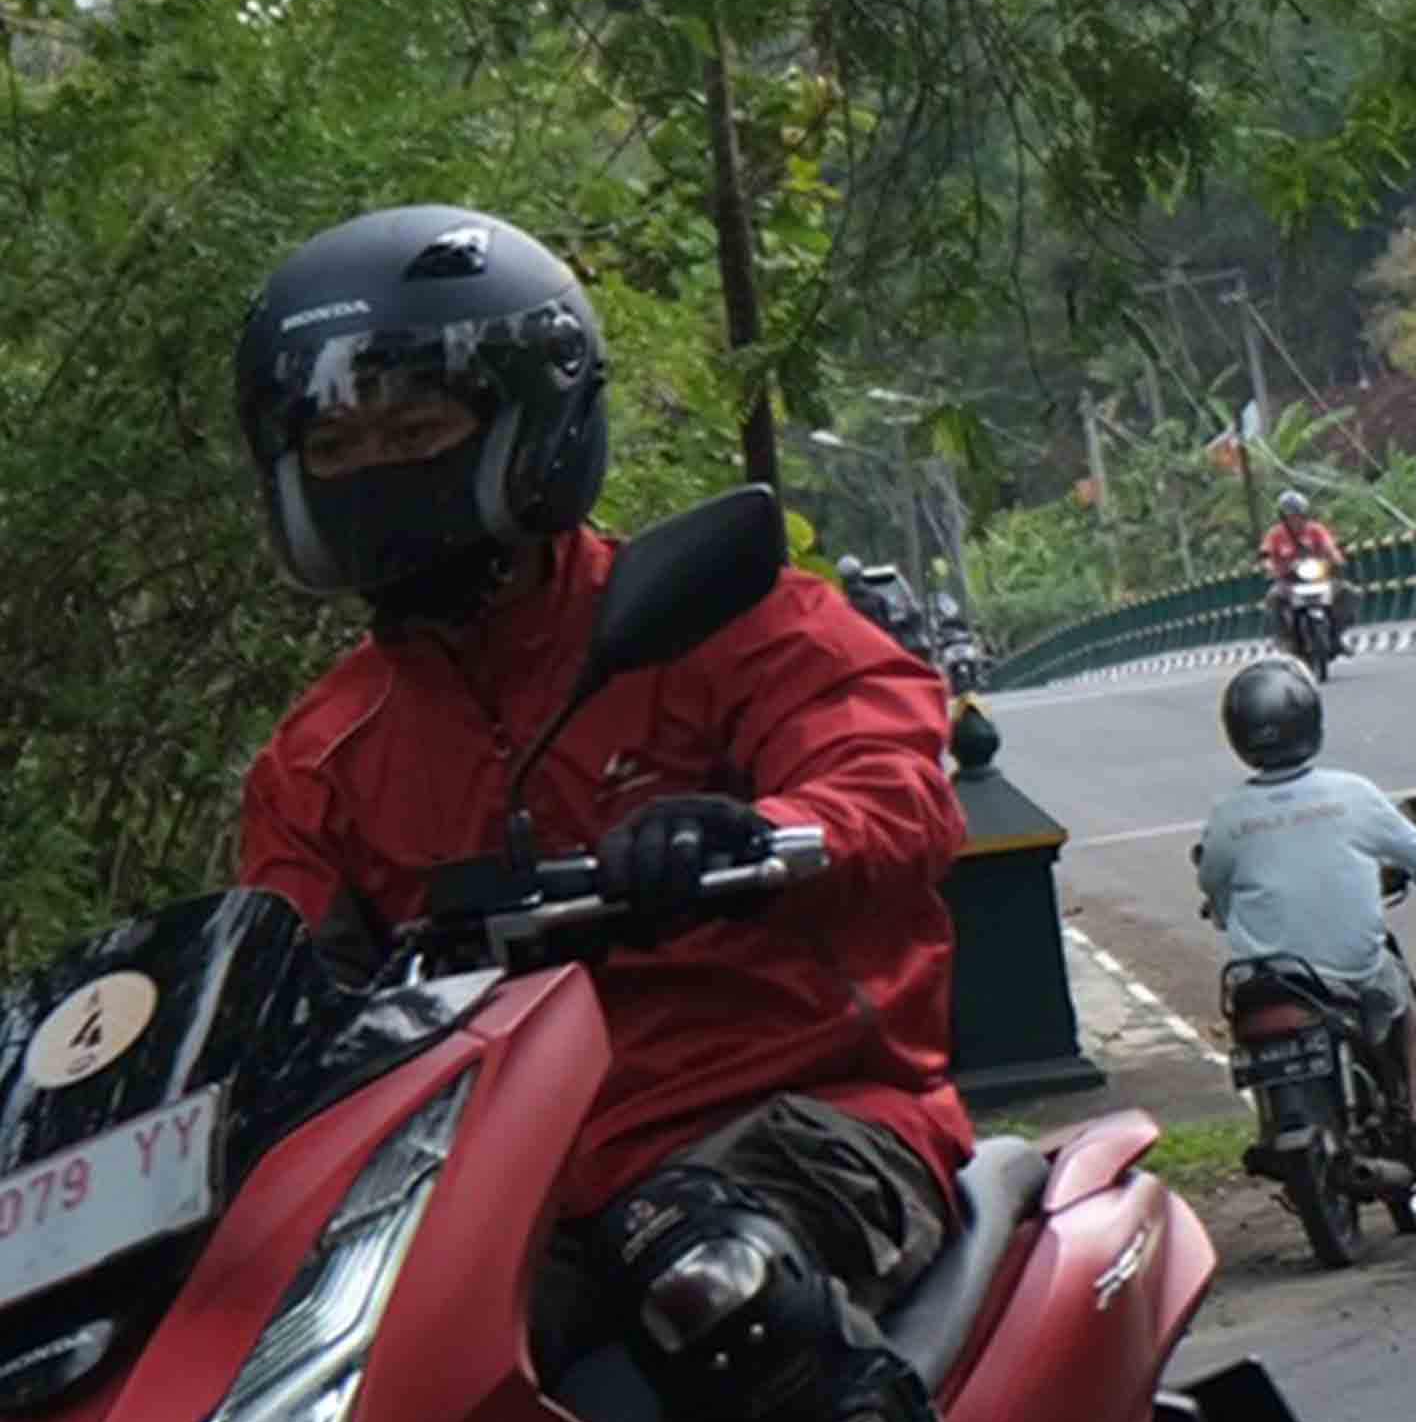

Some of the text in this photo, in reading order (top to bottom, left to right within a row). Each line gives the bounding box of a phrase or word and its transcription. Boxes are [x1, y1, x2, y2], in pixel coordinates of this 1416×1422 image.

[281, 299, 371, 332] HONDA
[68, 1009, 104, 1049] 4
[133, 1104, 203, 1177] YY
